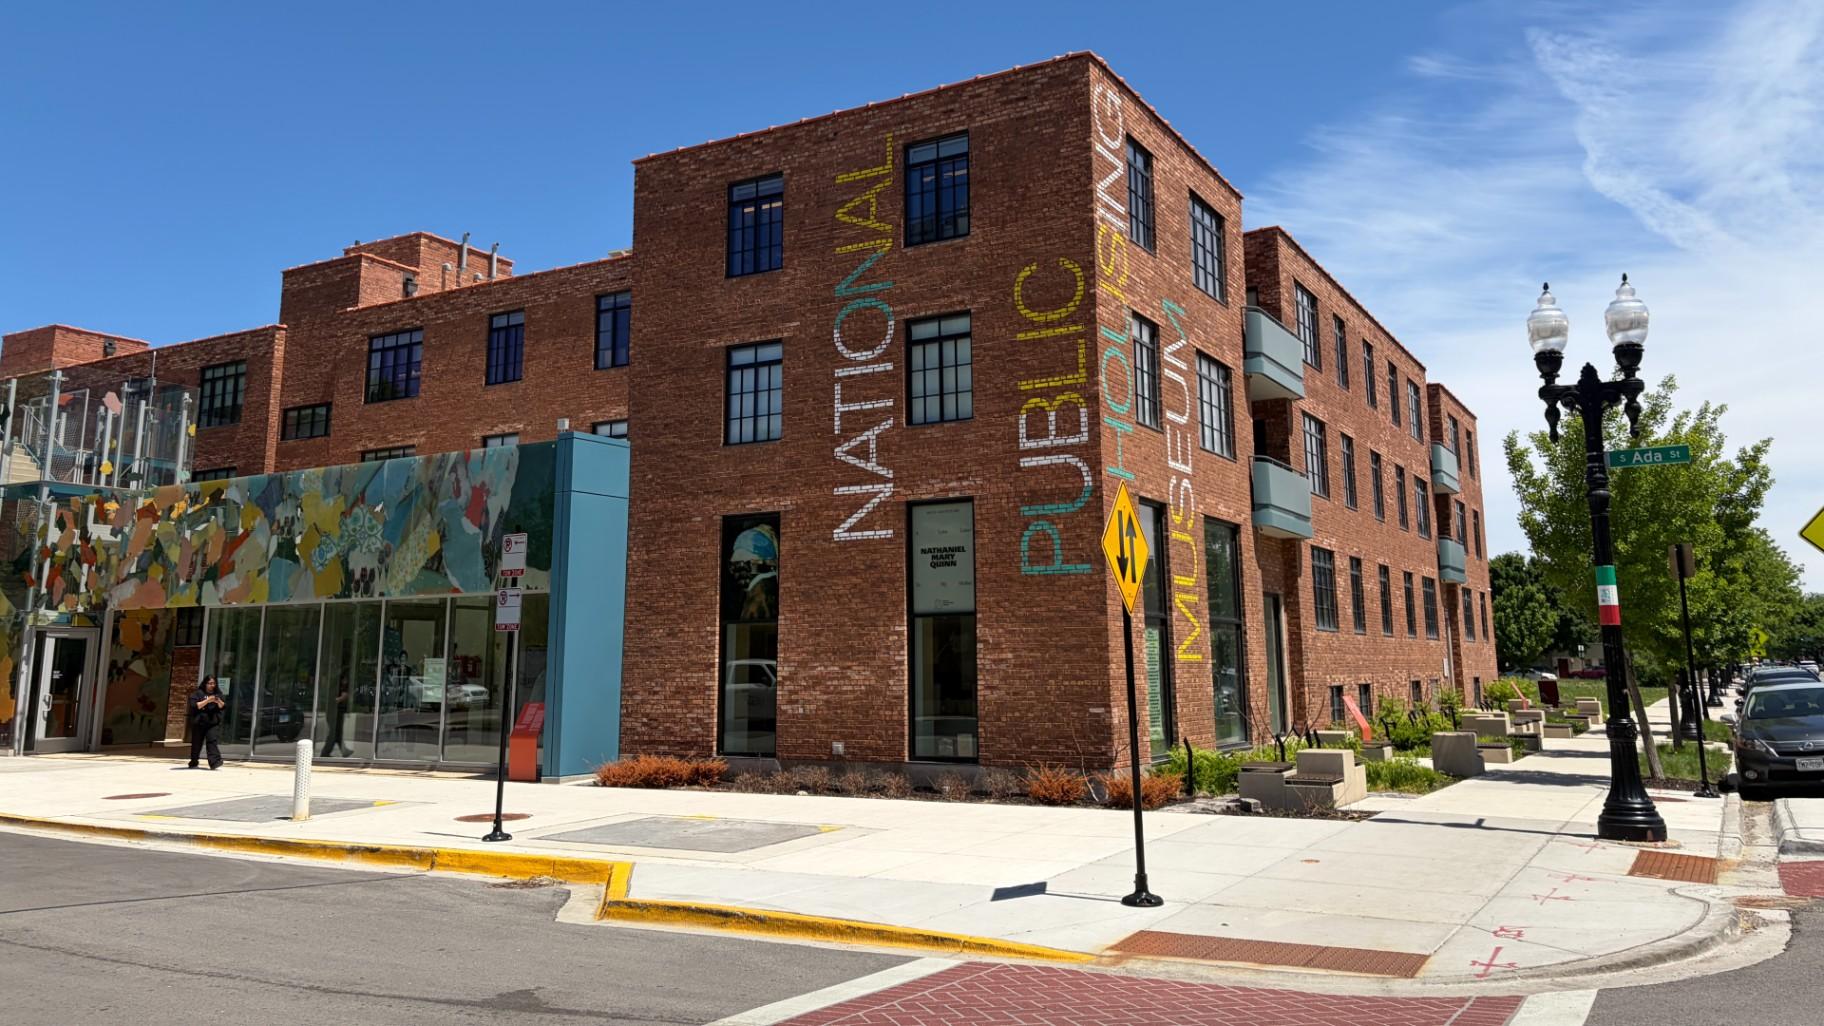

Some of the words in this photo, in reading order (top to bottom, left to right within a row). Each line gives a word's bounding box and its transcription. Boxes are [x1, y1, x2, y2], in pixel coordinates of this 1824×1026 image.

[833, 132, 895, 541] NATIONAL
[1014, 257, 1093, 575] PUBLIC
[1093, 84, 1135, 480] HOUSING
[920, 545, 966, 555] NATHANIEL
[929, 560, 957, 569] QUINN
[1162, 297, 1203, 662] MUSEUM
[1619, 454, 1626, 463] S
[1632, 450, 1663, 464] Ada
[1669, 450, 1680, 459] St
